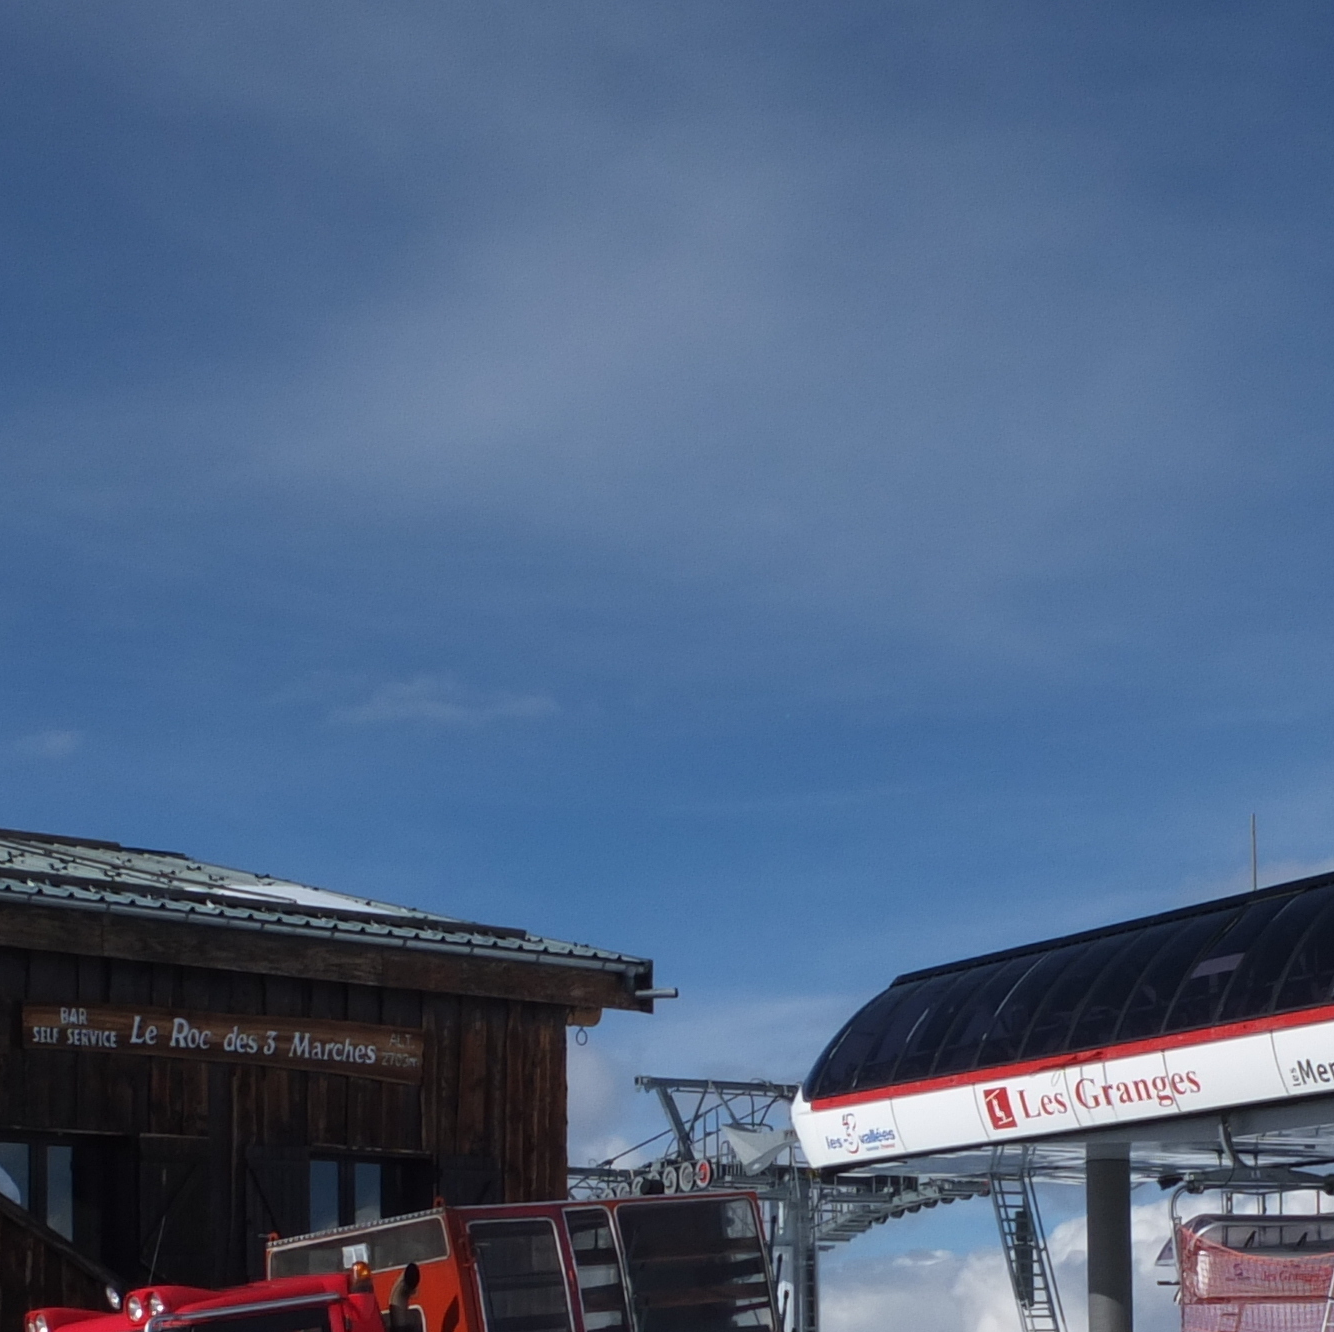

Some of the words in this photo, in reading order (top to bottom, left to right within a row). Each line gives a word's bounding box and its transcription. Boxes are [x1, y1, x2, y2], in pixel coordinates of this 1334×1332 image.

[60, 1007, 88, 1025] BAR
[32, 1026, 59, 1044] SELF
[66, 1028, 117, 1048] SERVICE
[129, 1014, 158, 1045] Le
[169, 1017, 212, 1050] Roc
[223, 1025, 258, 1054] des
[263, 1030, 279, 1055] 3
[288, 1031, 377, 1065] Marches
[1017, 1089, 1068, 1119] Les
[1075, 1070, 1202, 1108] Granges
